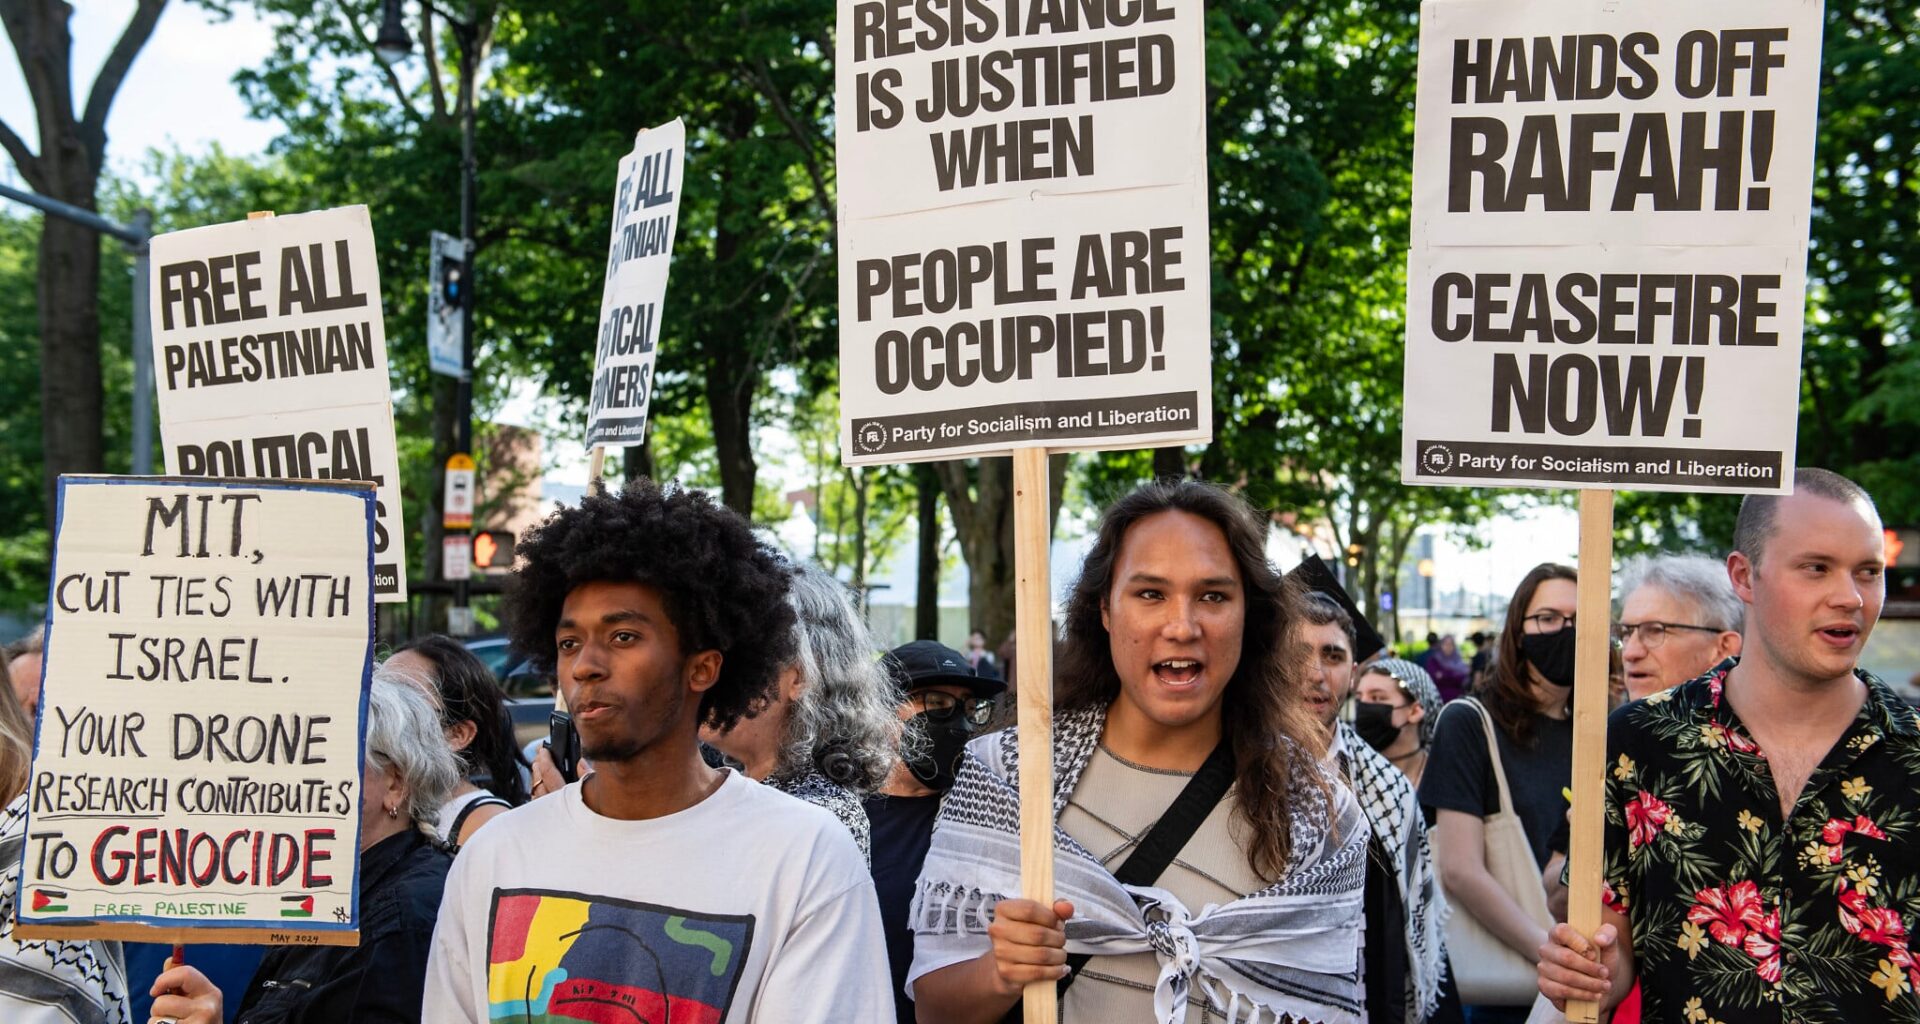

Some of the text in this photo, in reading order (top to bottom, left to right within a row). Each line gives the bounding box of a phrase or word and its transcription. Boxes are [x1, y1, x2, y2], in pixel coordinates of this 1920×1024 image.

[856, 34, 1176, 133] IS JUSTIFIED
[1451, 28, 1789, 104] HANDS OFF
[633, 148, 673, 212] ALL
[929, 115, 1094, 192] WHEN
[1447, 110, 1776, 213] RAFAH!
[160, 250, 268, 331] FREE
[279, 239, 368, 316] ALL
[857, 226, 1185, 323] PEOPLE ARE
[1431, 272, 1781, 346] CEASEFIRE
[164, 321, 375, 390] PALESTINIAN
[875, 305, 1166, 395] OCCUPIED!
[892, 406, 1190, 443] Party for Socialism and Liberation
[1491, 352, 1706, 438] NOW!
[605, 424, 618, 436] and
[1459, 453, 1773, 478] Party for Socialism and Liberation
[56, 571, 350, 618] CUT TIES WITH
[106, 633, 289, 684] ISRAEL.
[54, 706, 331, 764] YOUR DRONE
[33, 771, 353, 815] RESEARCH CONTRIBUTES
[31, 825, 335, 888] TO GENOCIDE
[94, 902, 248, 916] FREE PALESTINE
[271, 934, 319, 944] MAY 2024
